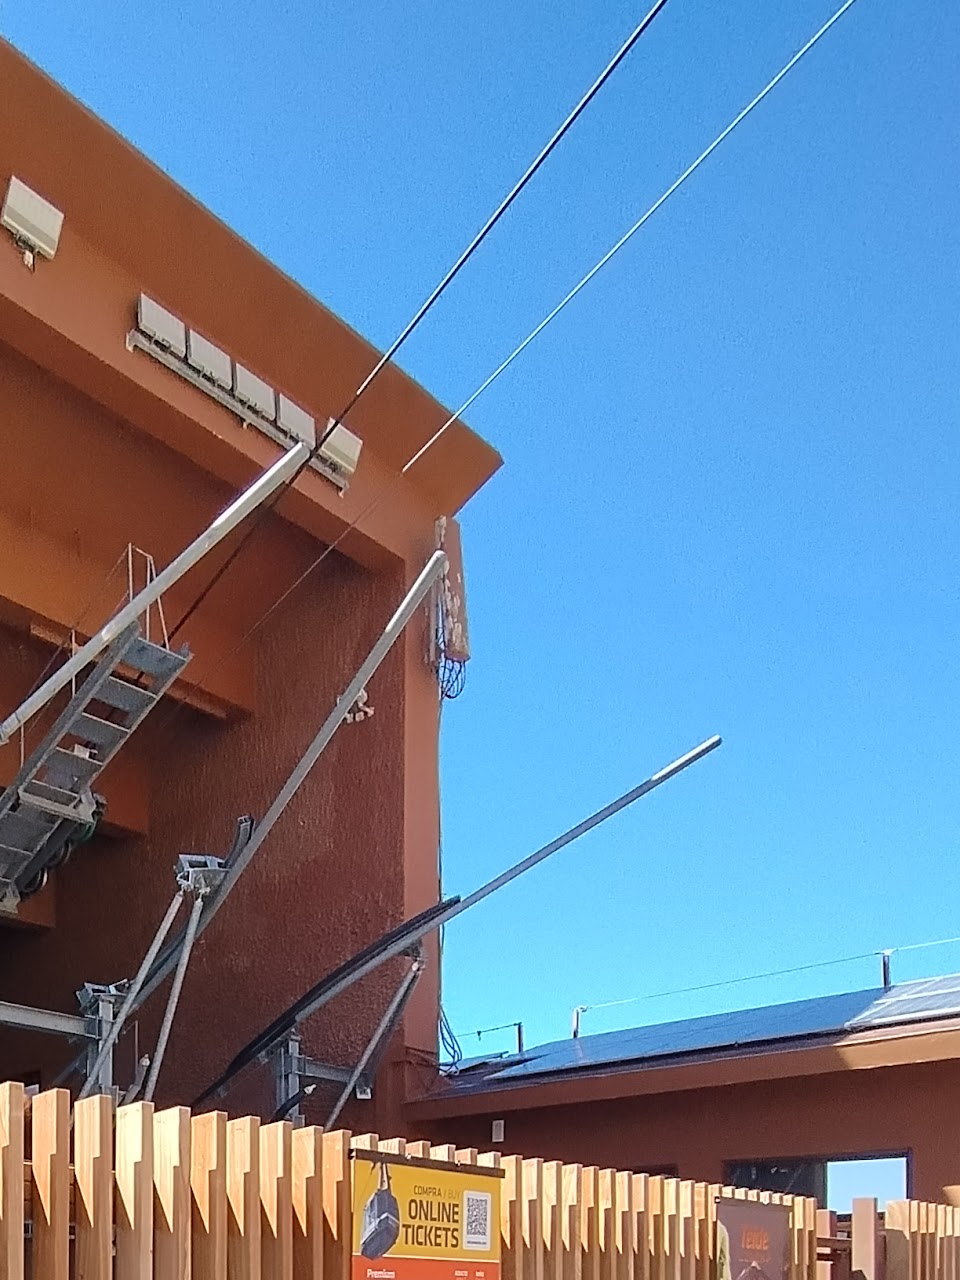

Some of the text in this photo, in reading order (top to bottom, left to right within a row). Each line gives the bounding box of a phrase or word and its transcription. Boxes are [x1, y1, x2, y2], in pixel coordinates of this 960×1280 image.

[413, 1185, 442, 1197] COMPRA
[408, 1198, 459, 1223] ONLINE
[402, 1224, 459, 1248] TICKETS
[366, 1268, 395, 1279] Premium
